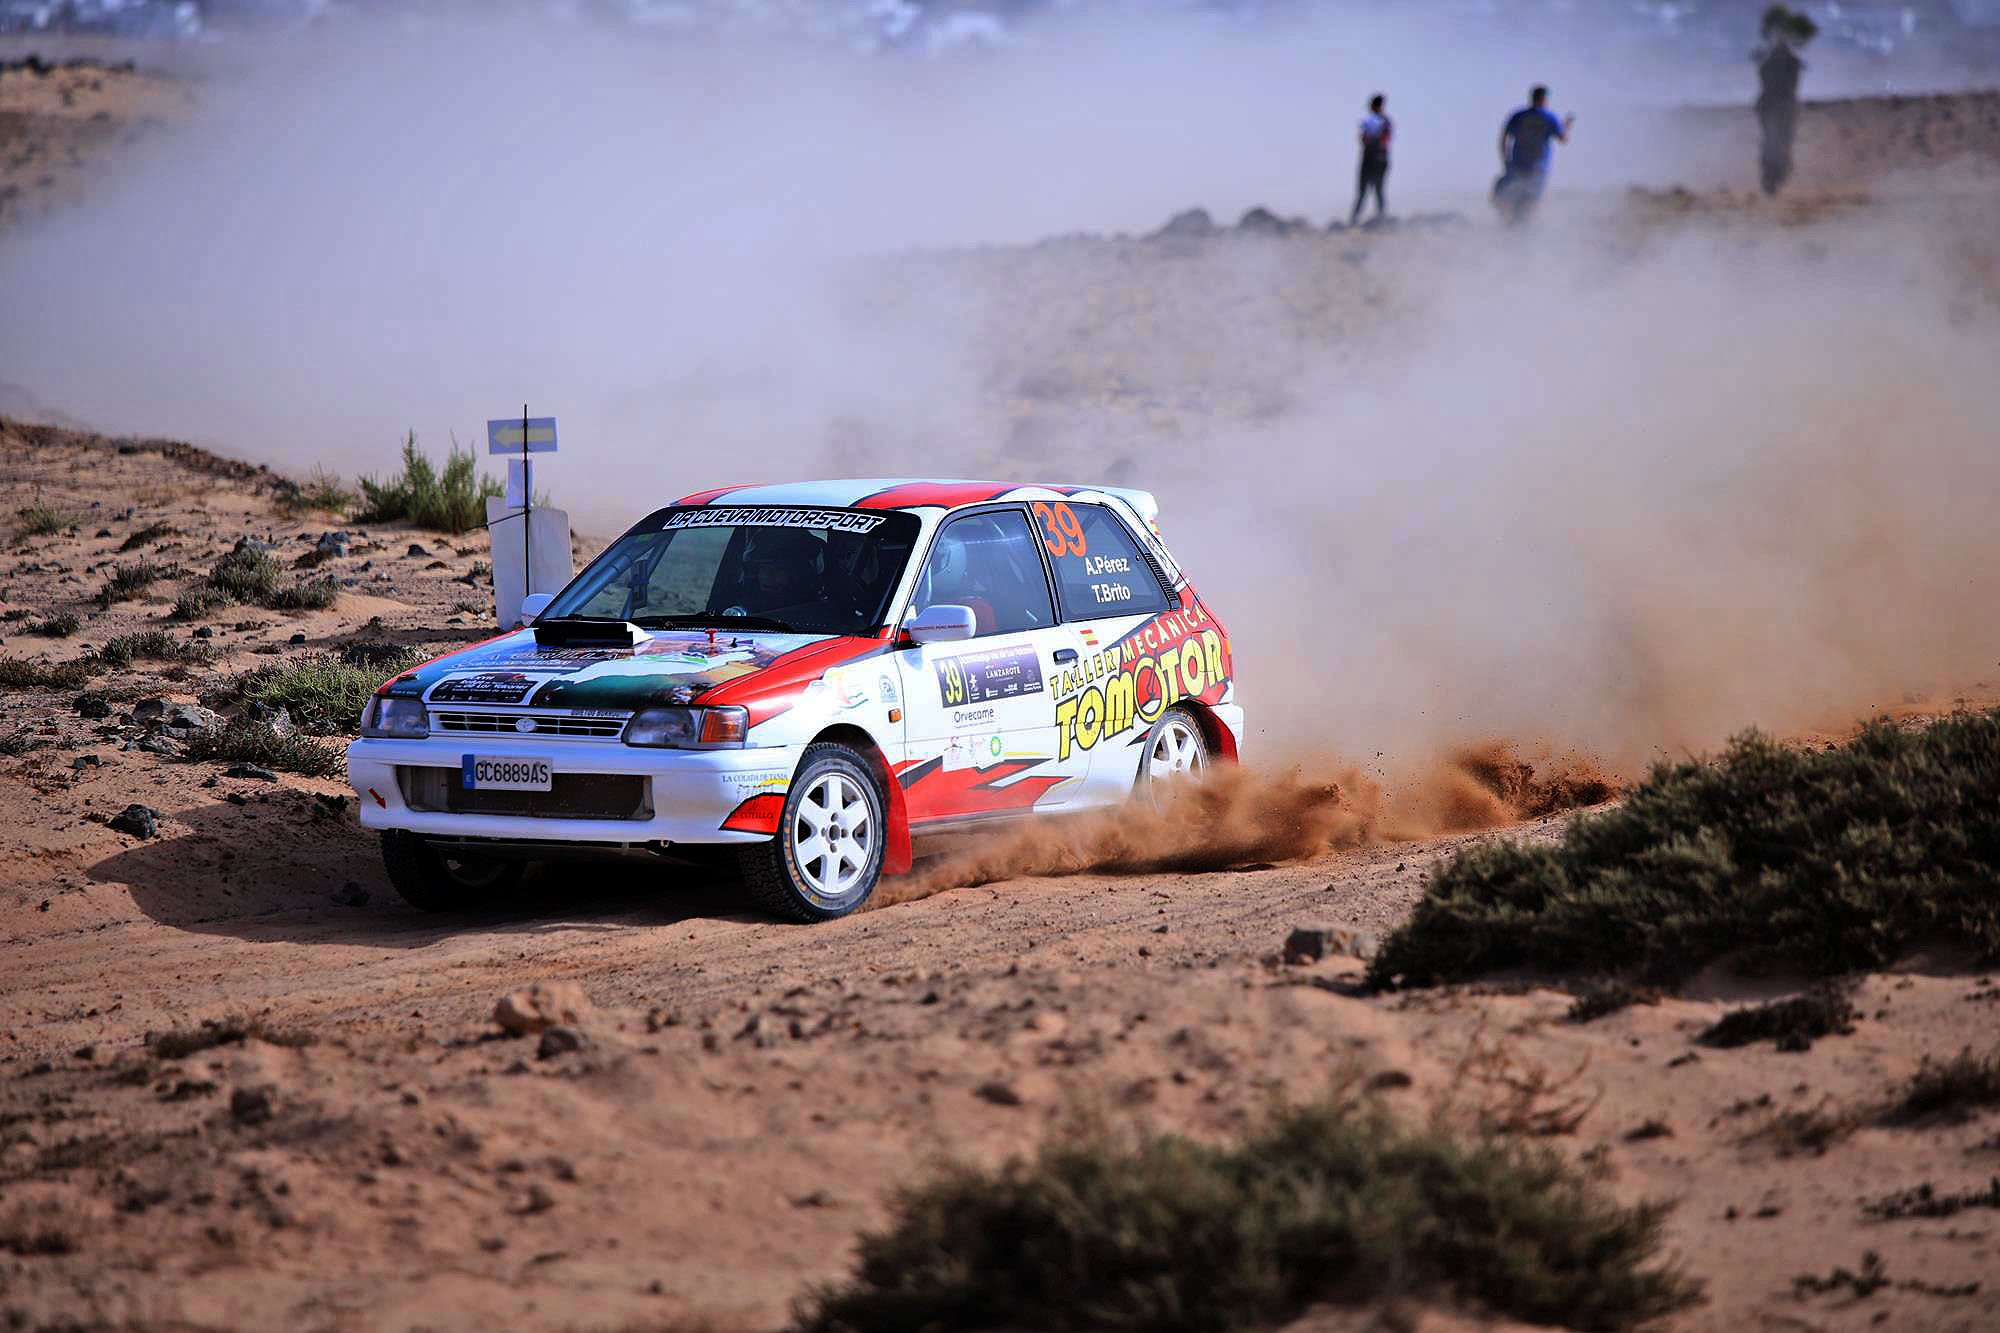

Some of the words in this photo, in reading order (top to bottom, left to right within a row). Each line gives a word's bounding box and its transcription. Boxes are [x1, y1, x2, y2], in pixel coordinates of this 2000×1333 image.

[1033, 502, 1087, 557] 39
[1085, 555, 1130, 575] A.Pérez
[1091, 583, 1131, 602] T.Brito
[941, 660, 963, 704] 39
[985, 666, 1021, 679] LANZAROTE
[1049, 650, 1117, 700] TALLER
[1056, 629, 1226, 762] TOMOTOR
[953, 707, 994, 723] Orvecome
[475, 762, 549, 784] GC6889AS
